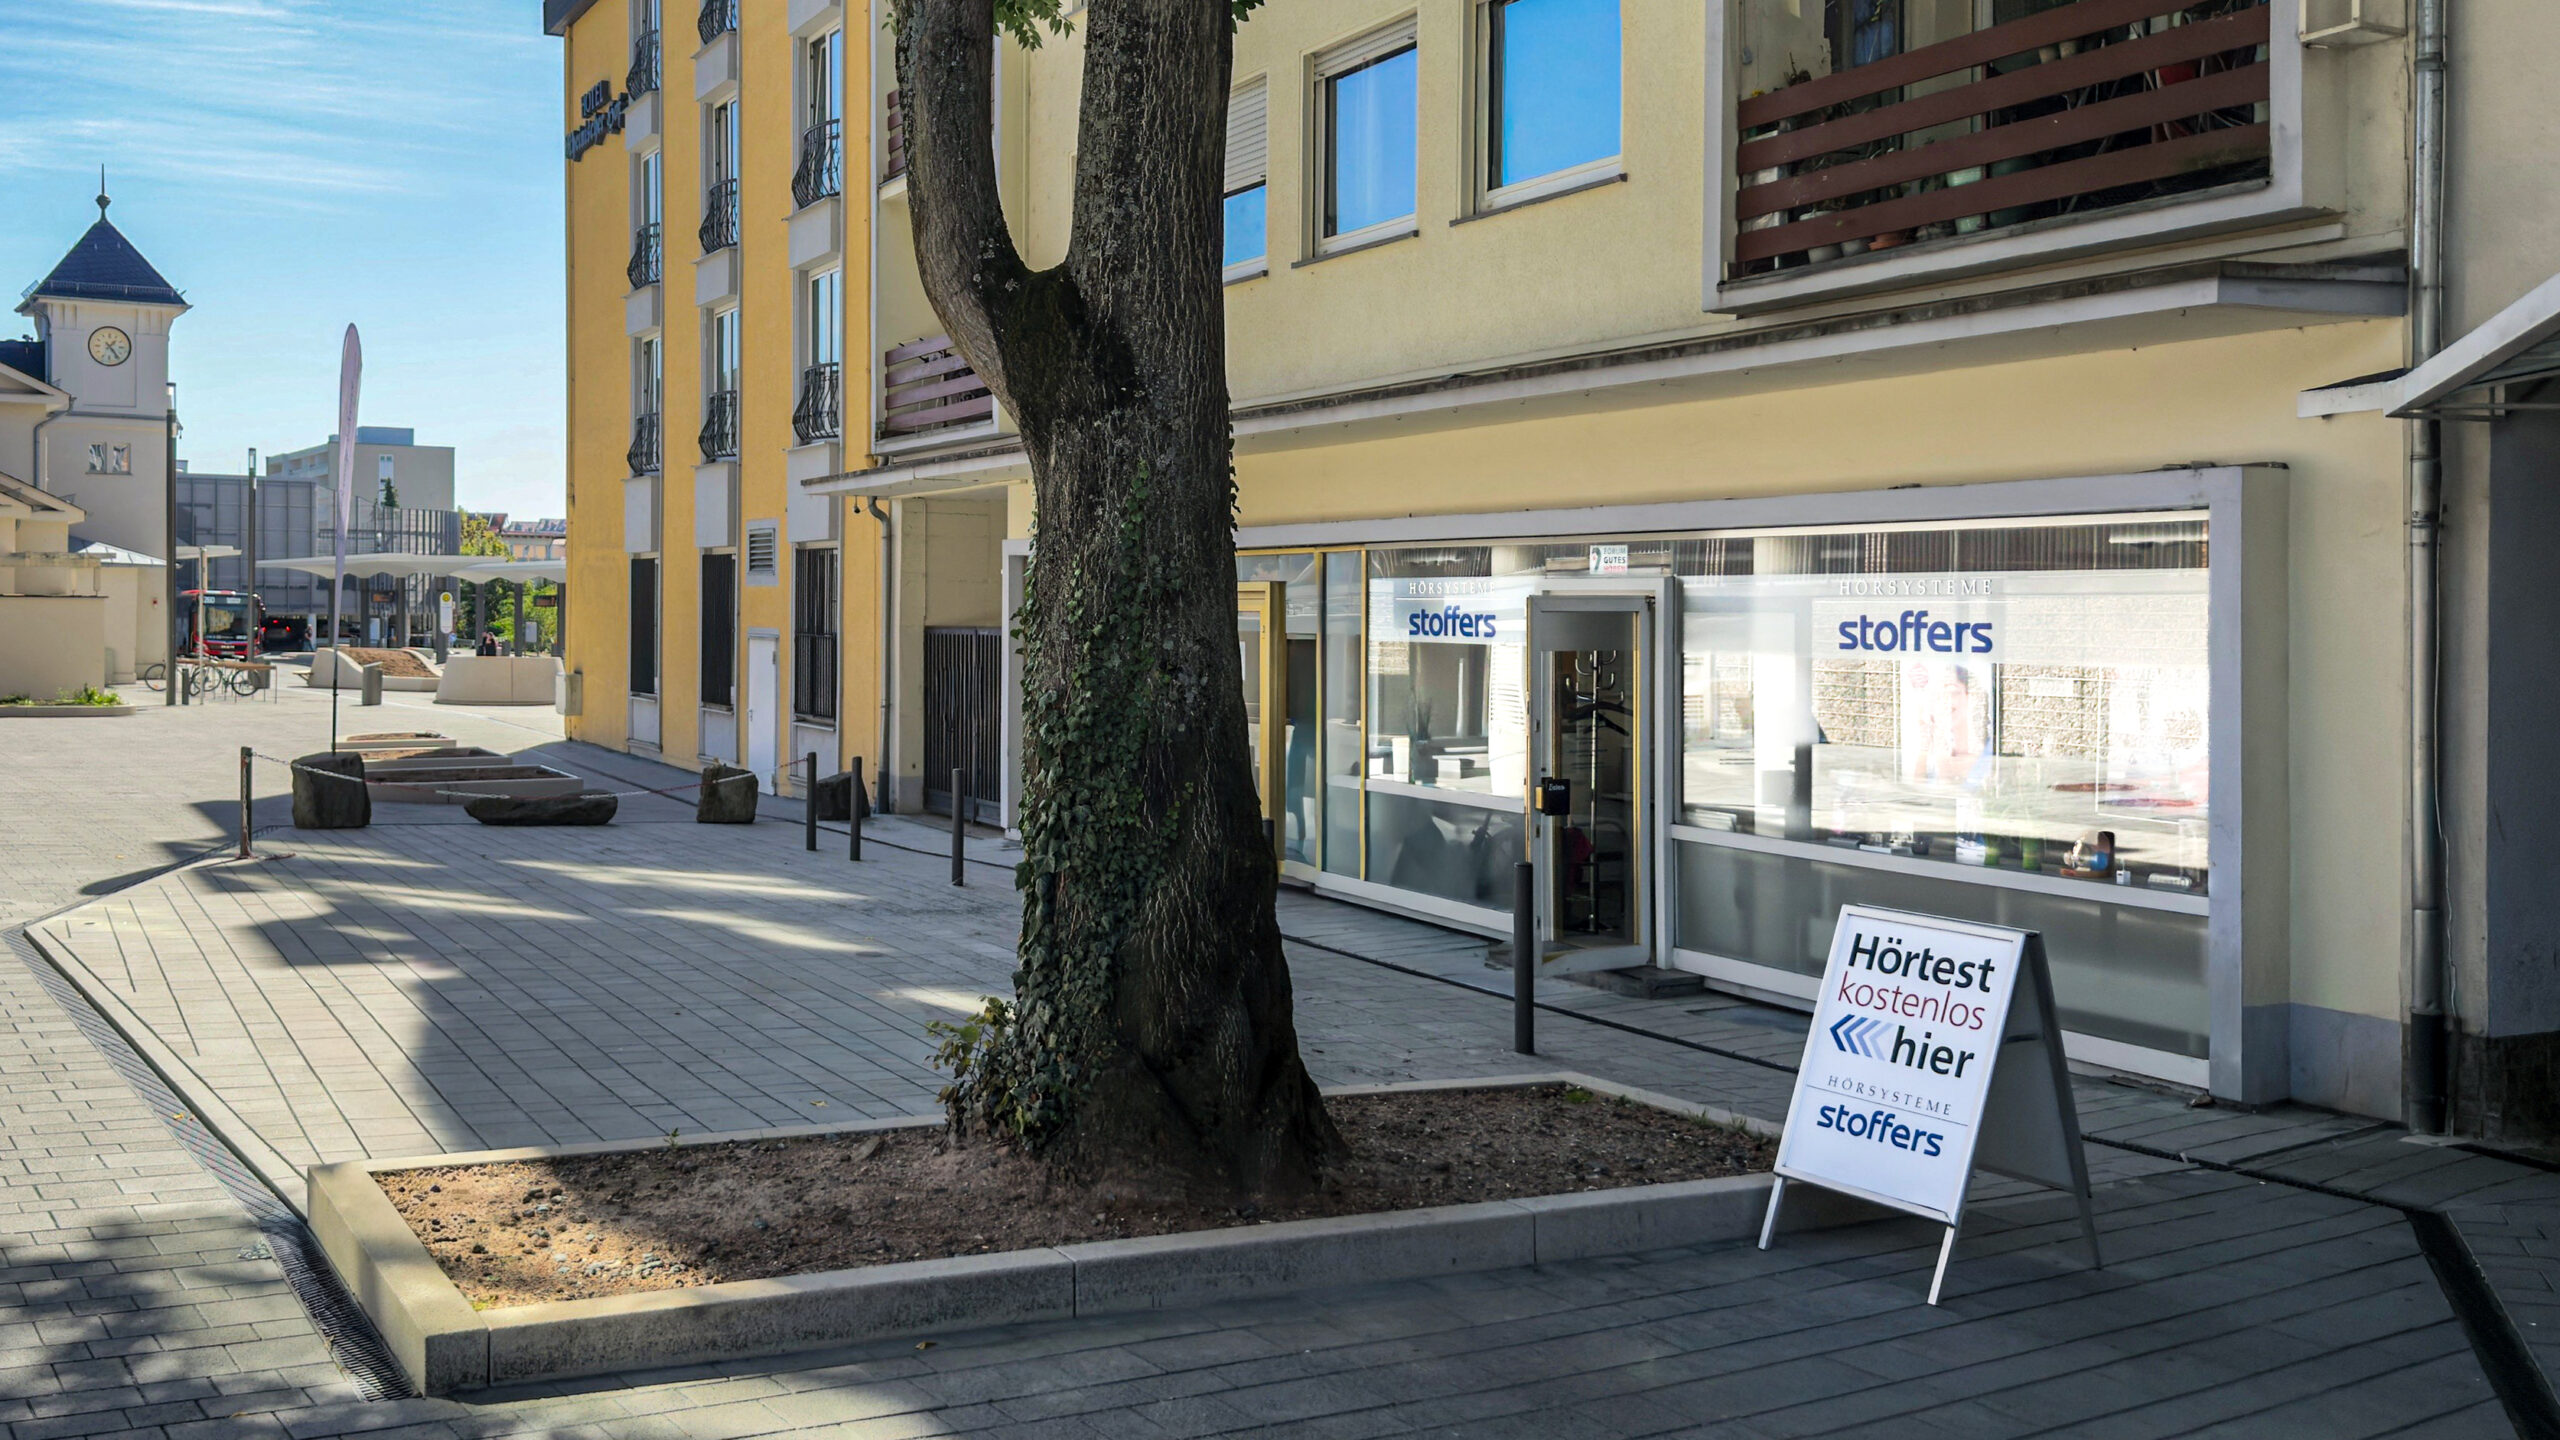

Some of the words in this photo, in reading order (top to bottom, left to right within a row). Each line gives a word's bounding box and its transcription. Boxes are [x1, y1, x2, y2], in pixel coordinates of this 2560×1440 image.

[1603, 556, 1626, 564] GUTES
[1409, 580, 1496, 595] HÖRSYSTEME
[1838, 578, 1993, 596] HÖRSYSTEME
[1409, 605, 1497, 638] stoffers
[1838, 610, 1993, 653] stoffers
[1848, 933, 1995, 993] Hörtest
[1838, 970, 1986, 1030] kostenlos
[1890, 1025, 1975, 1078] hier
[1828, 1075, 1952, 1116] HÖRSYSTEME
[1816, 1104, 1944, 1157] stoffers
